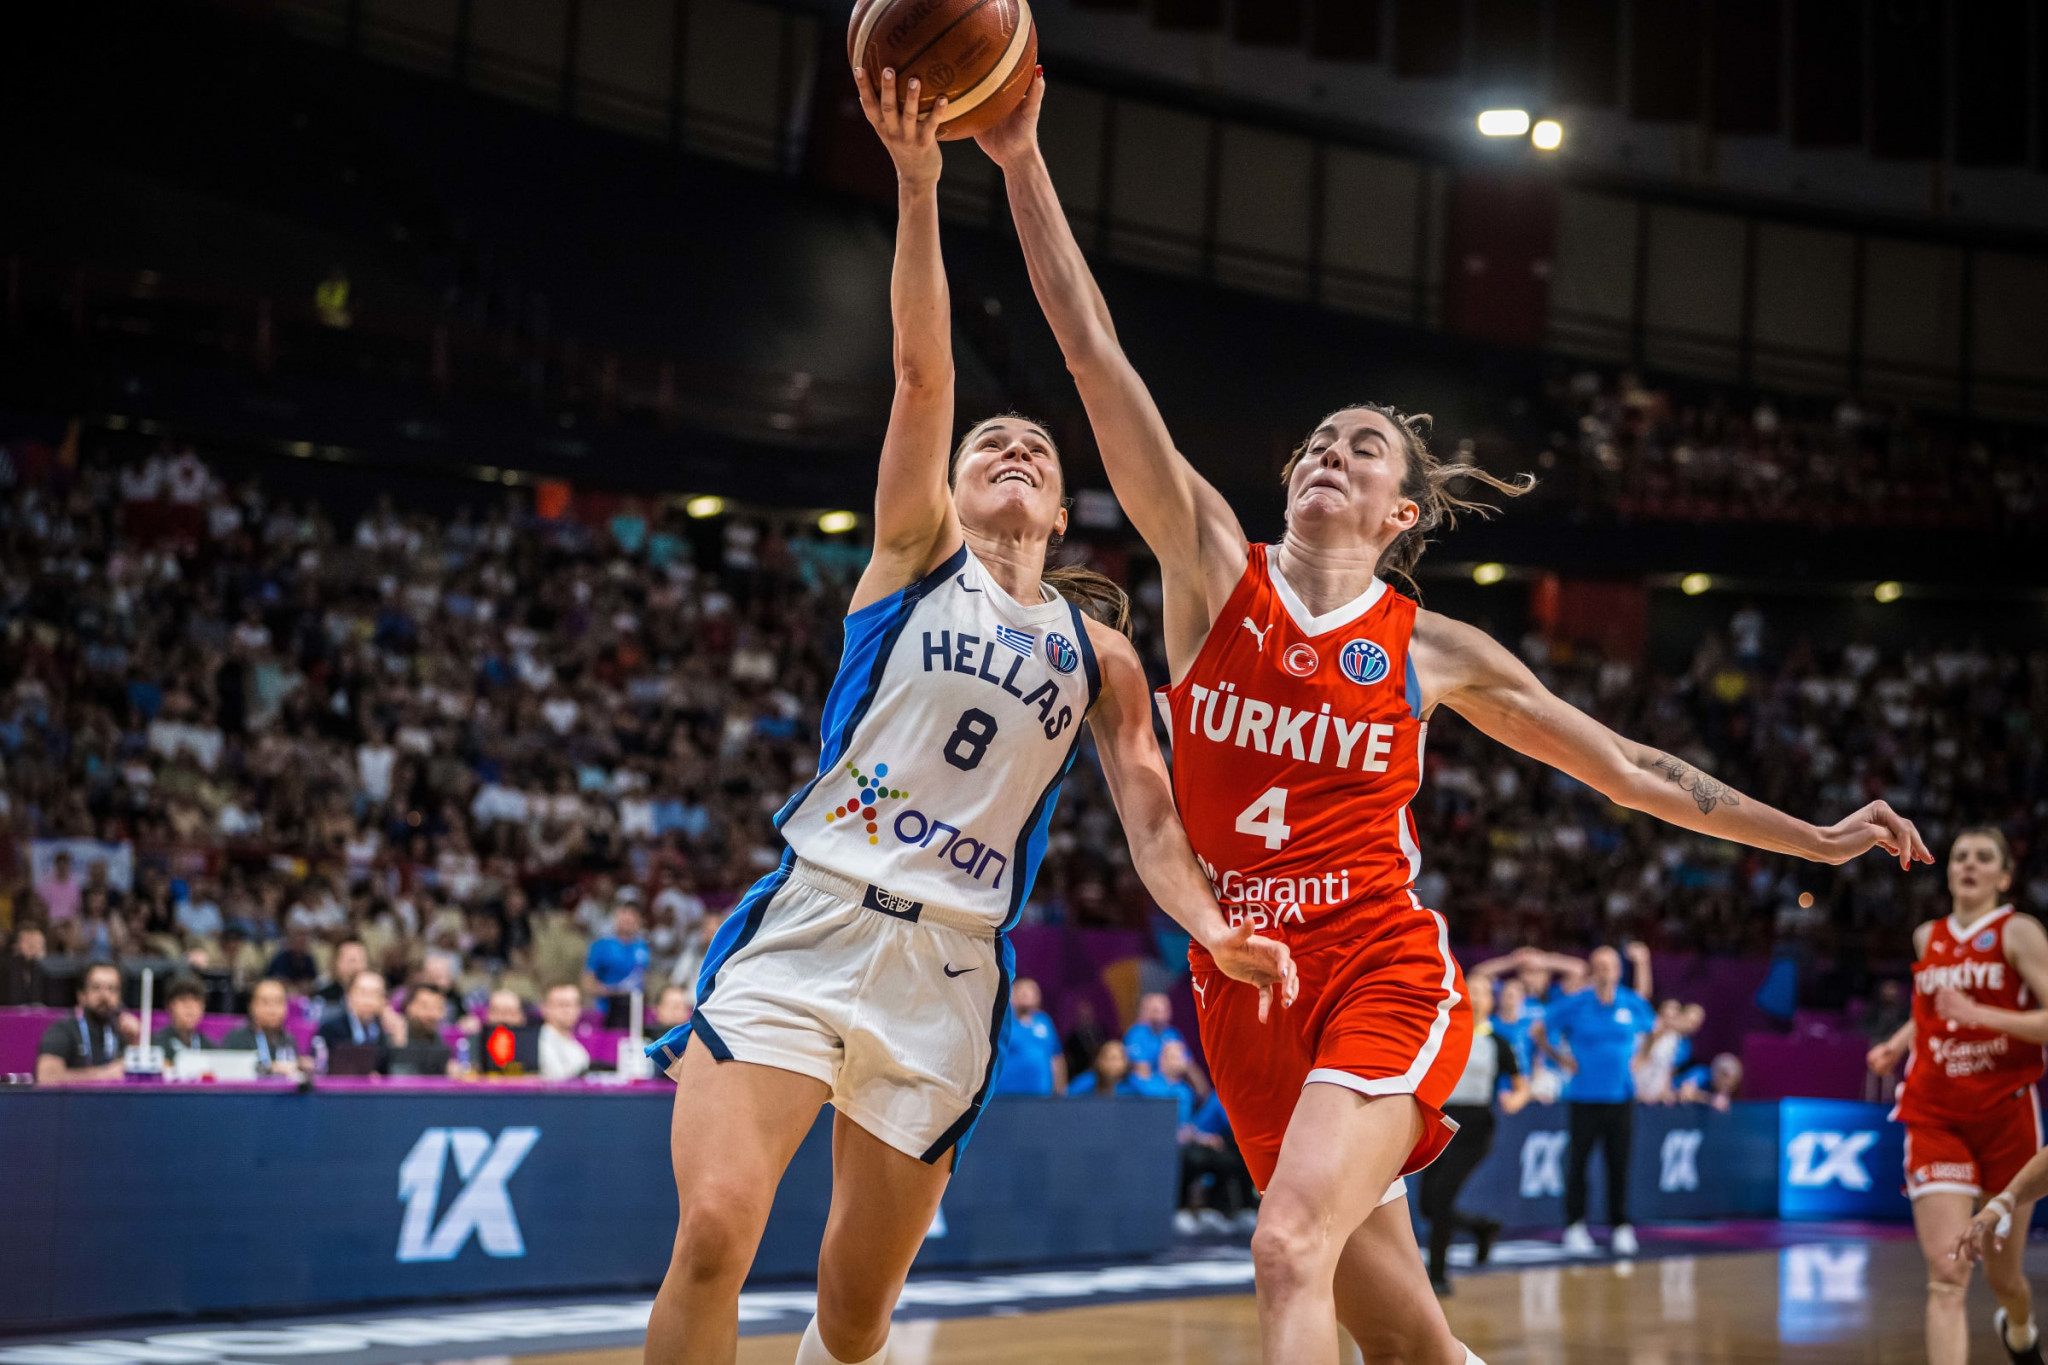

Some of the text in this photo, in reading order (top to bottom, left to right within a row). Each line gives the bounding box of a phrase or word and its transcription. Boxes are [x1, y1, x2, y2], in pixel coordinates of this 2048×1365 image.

[922, 630, 1072, 740] HELLAS
[943, 707, 998, 771] 8
[1190, 681, 1394, 772] TÜRKİYE
[1235, 787, 1291, 850] 4
[1222, 869, 1349, 905] Garanti
[1787, 1130, 1878, 1193] 1X
[396, 1126, 541, 1262] 1X
